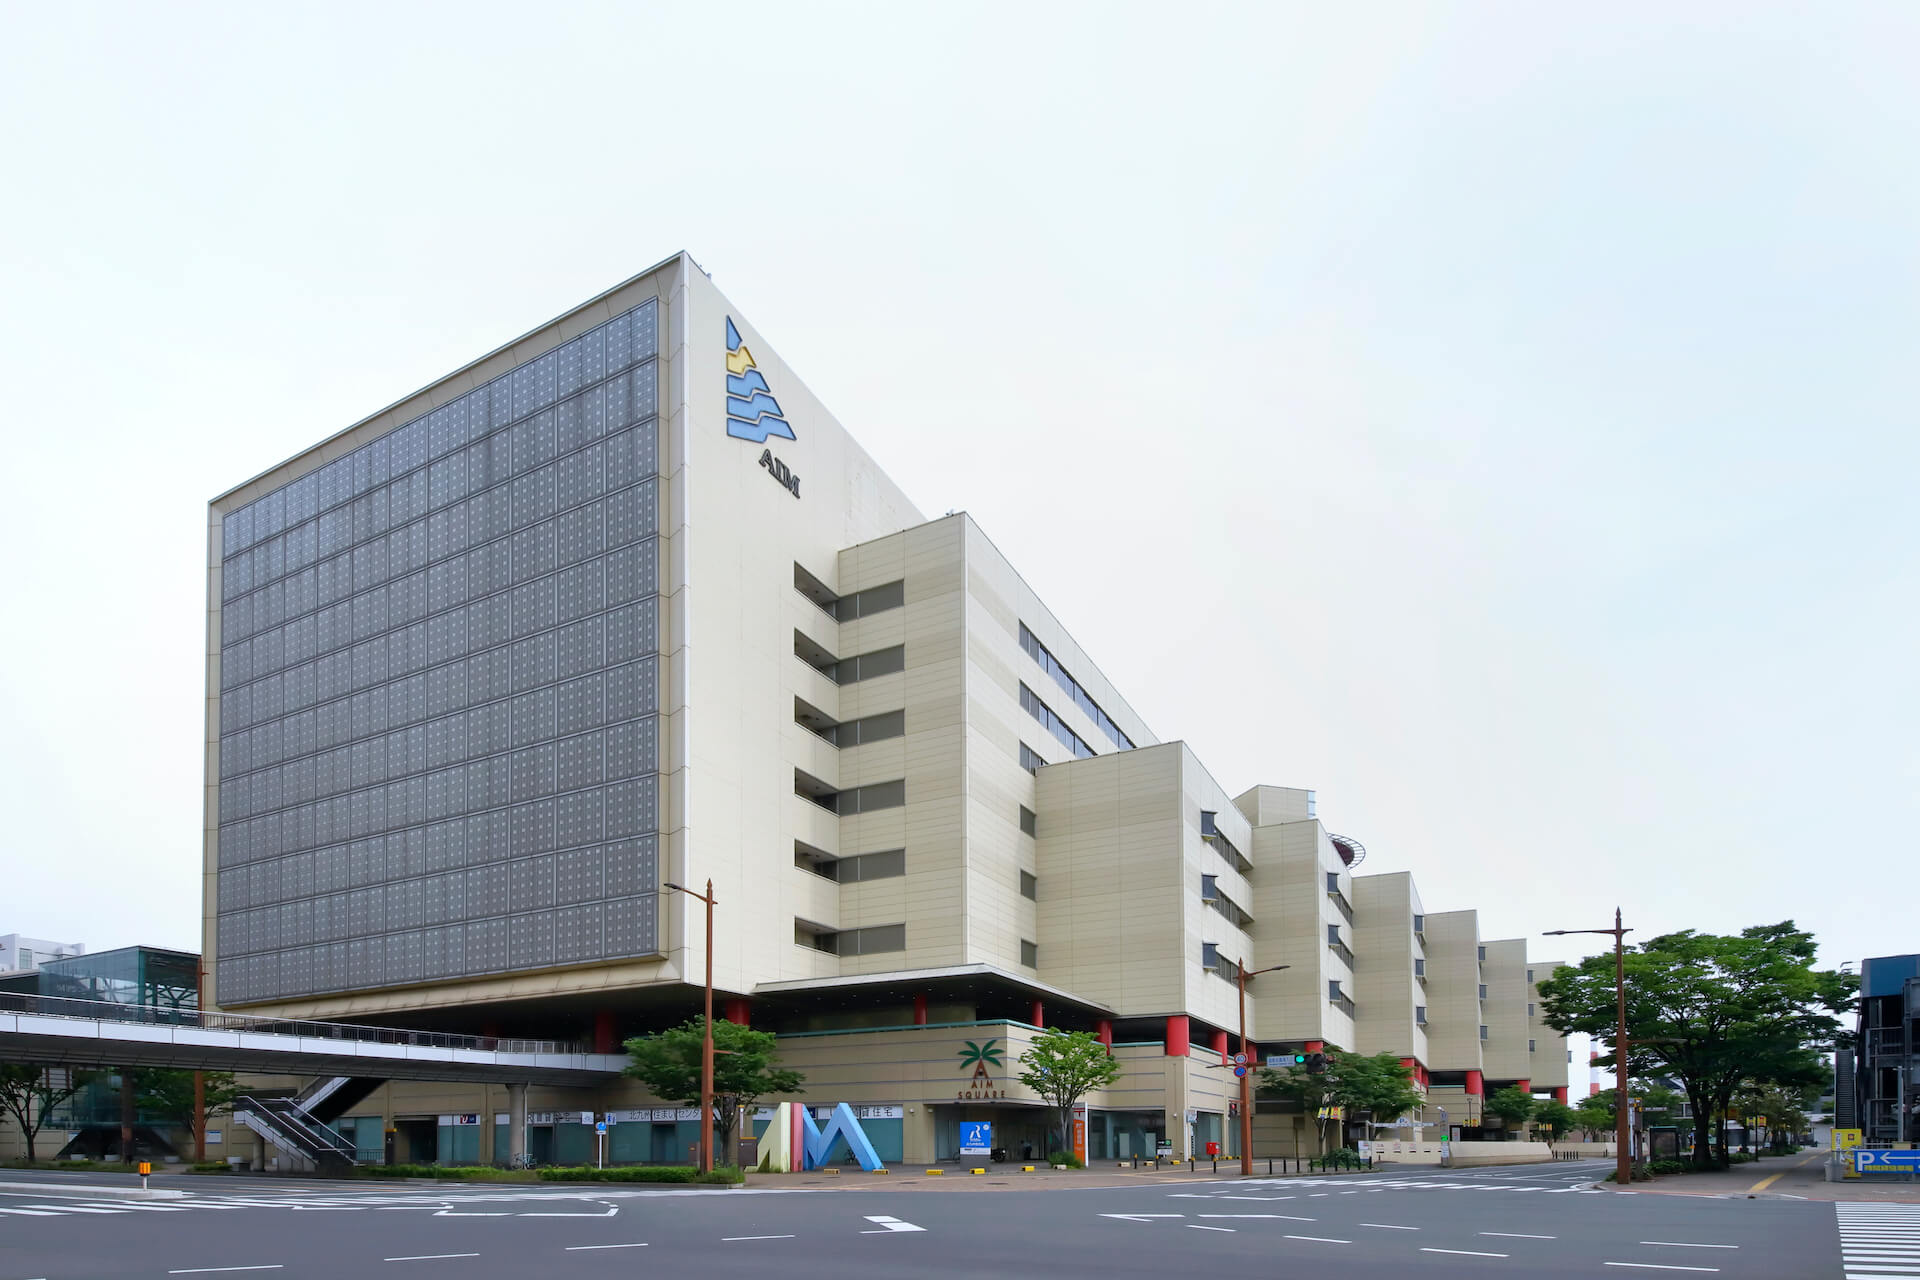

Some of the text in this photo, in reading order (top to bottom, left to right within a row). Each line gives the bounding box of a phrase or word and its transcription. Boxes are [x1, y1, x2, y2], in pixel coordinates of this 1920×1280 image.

[758, 448, 801, 499] AIM
[971, 1080, 994, 1088] AIM
[958, 1090, 1006, 1099] SQUARE
[628, 1107, 700, 1120] 北九州住まいセンタ
[1857, 1152, 1875, 1172] P
